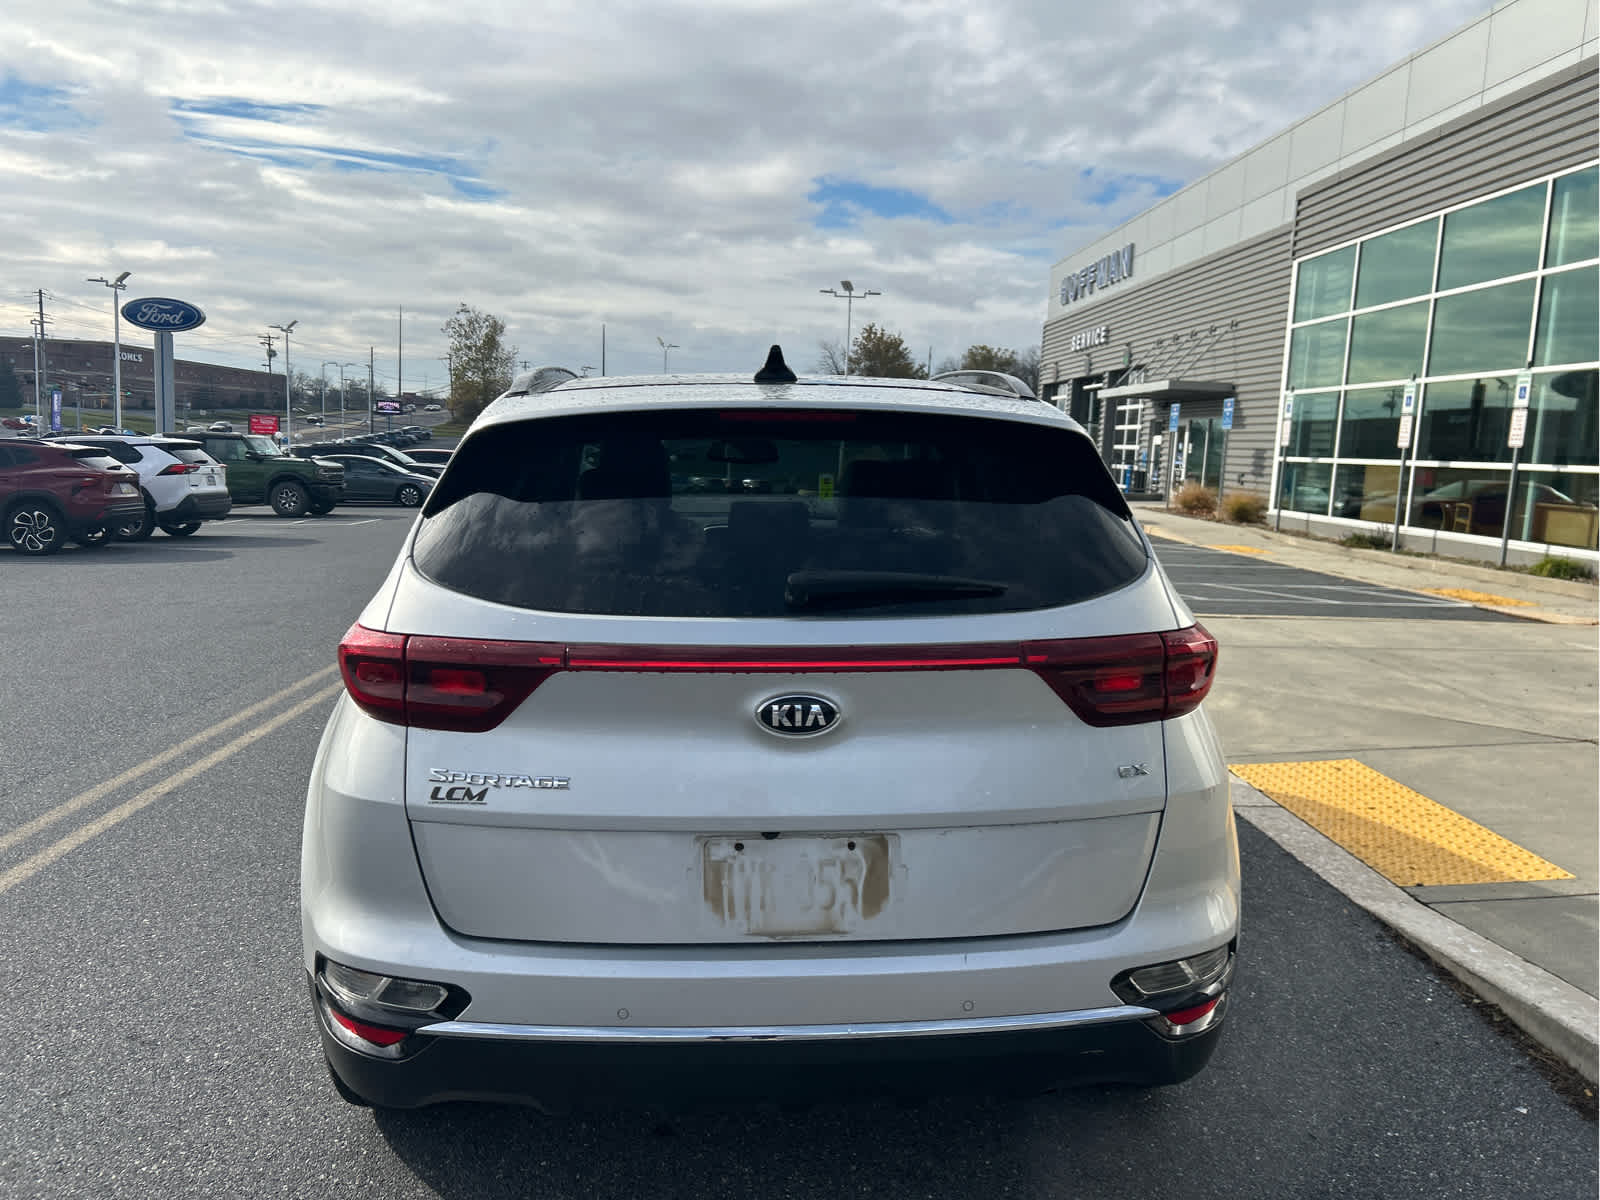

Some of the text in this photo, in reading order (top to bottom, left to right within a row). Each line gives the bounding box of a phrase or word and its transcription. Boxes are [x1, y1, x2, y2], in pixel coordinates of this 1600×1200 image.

[137, 303, 184, 325] Ford
[1071, 326, 1107, 351] SERVICE
[771, 704, 826, 727] KIA
[429, 767, 571, 790] SPORTAGE
[1117, 763, 1150, 778] EX
[430, 786, 489, 802] LCM
